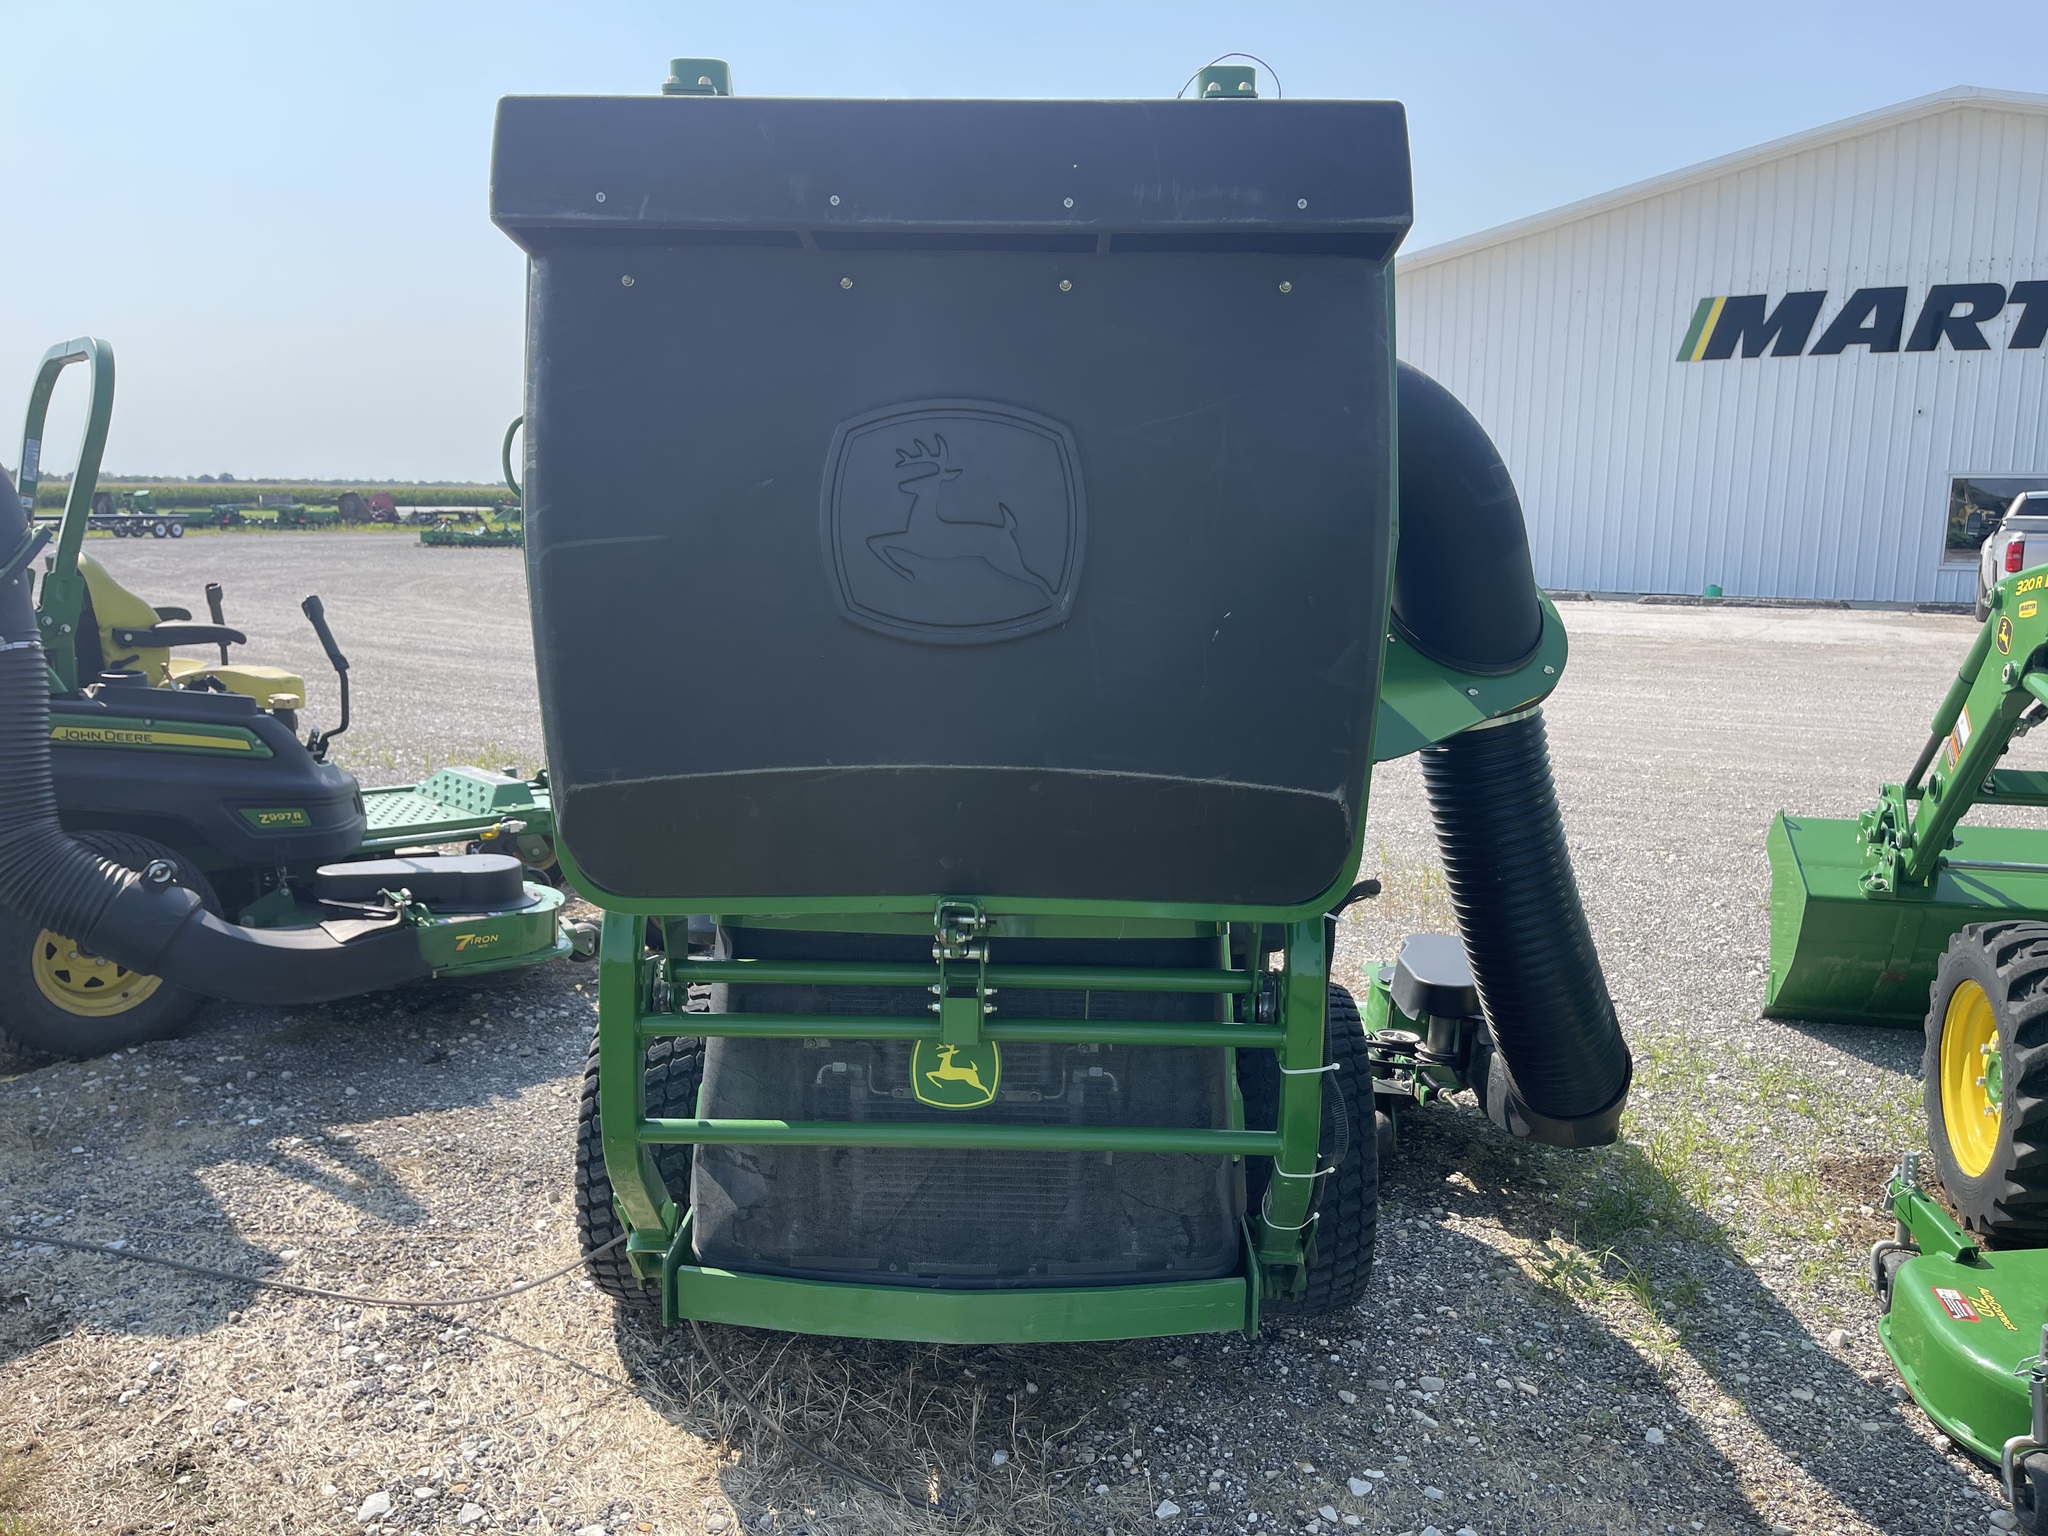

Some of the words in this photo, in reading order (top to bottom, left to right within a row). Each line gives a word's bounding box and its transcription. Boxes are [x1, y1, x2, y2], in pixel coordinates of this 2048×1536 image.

[1701, 281, 2048, 360] MART
[60, 728, 101, 740] JOHN
[104, 730, 153, 743] DEERE
[1976, 1285, 2019, 1332] AutoConnect
